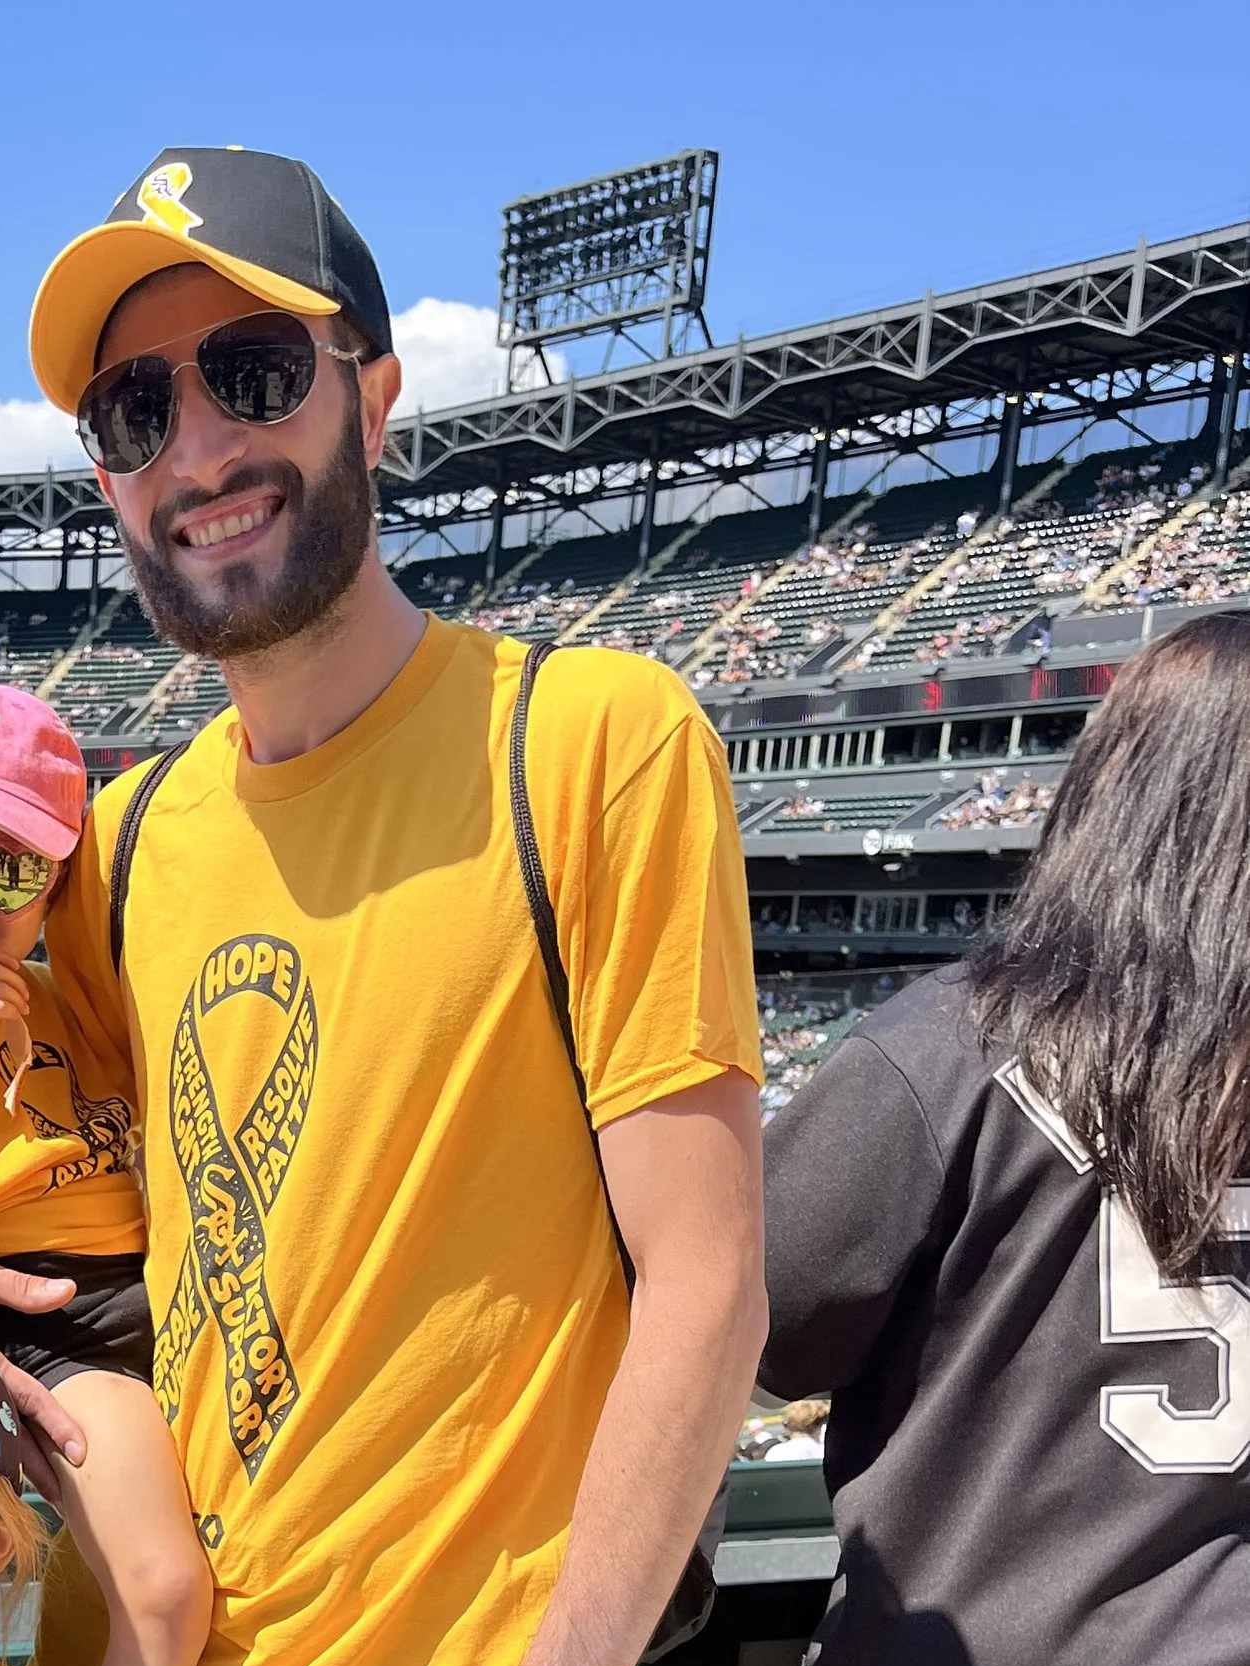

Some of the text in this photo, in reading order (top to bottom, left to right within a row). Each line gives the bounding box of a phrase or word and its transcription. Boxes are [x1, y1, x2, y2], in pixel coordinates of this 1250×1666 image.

[204, 941, 294, 1004] HOPE
[173, 1050, 201, 1183] FIGHT
[178, 1022, 223, 1163] STRENGTH
[241, 1000, 314, 1166] RESOLVE
[256, 1041, 314, 1204] FAITH
[208, 1270, 274, 1457] SUPPORT
[239, 1252, 296, 1416] VICTORY
